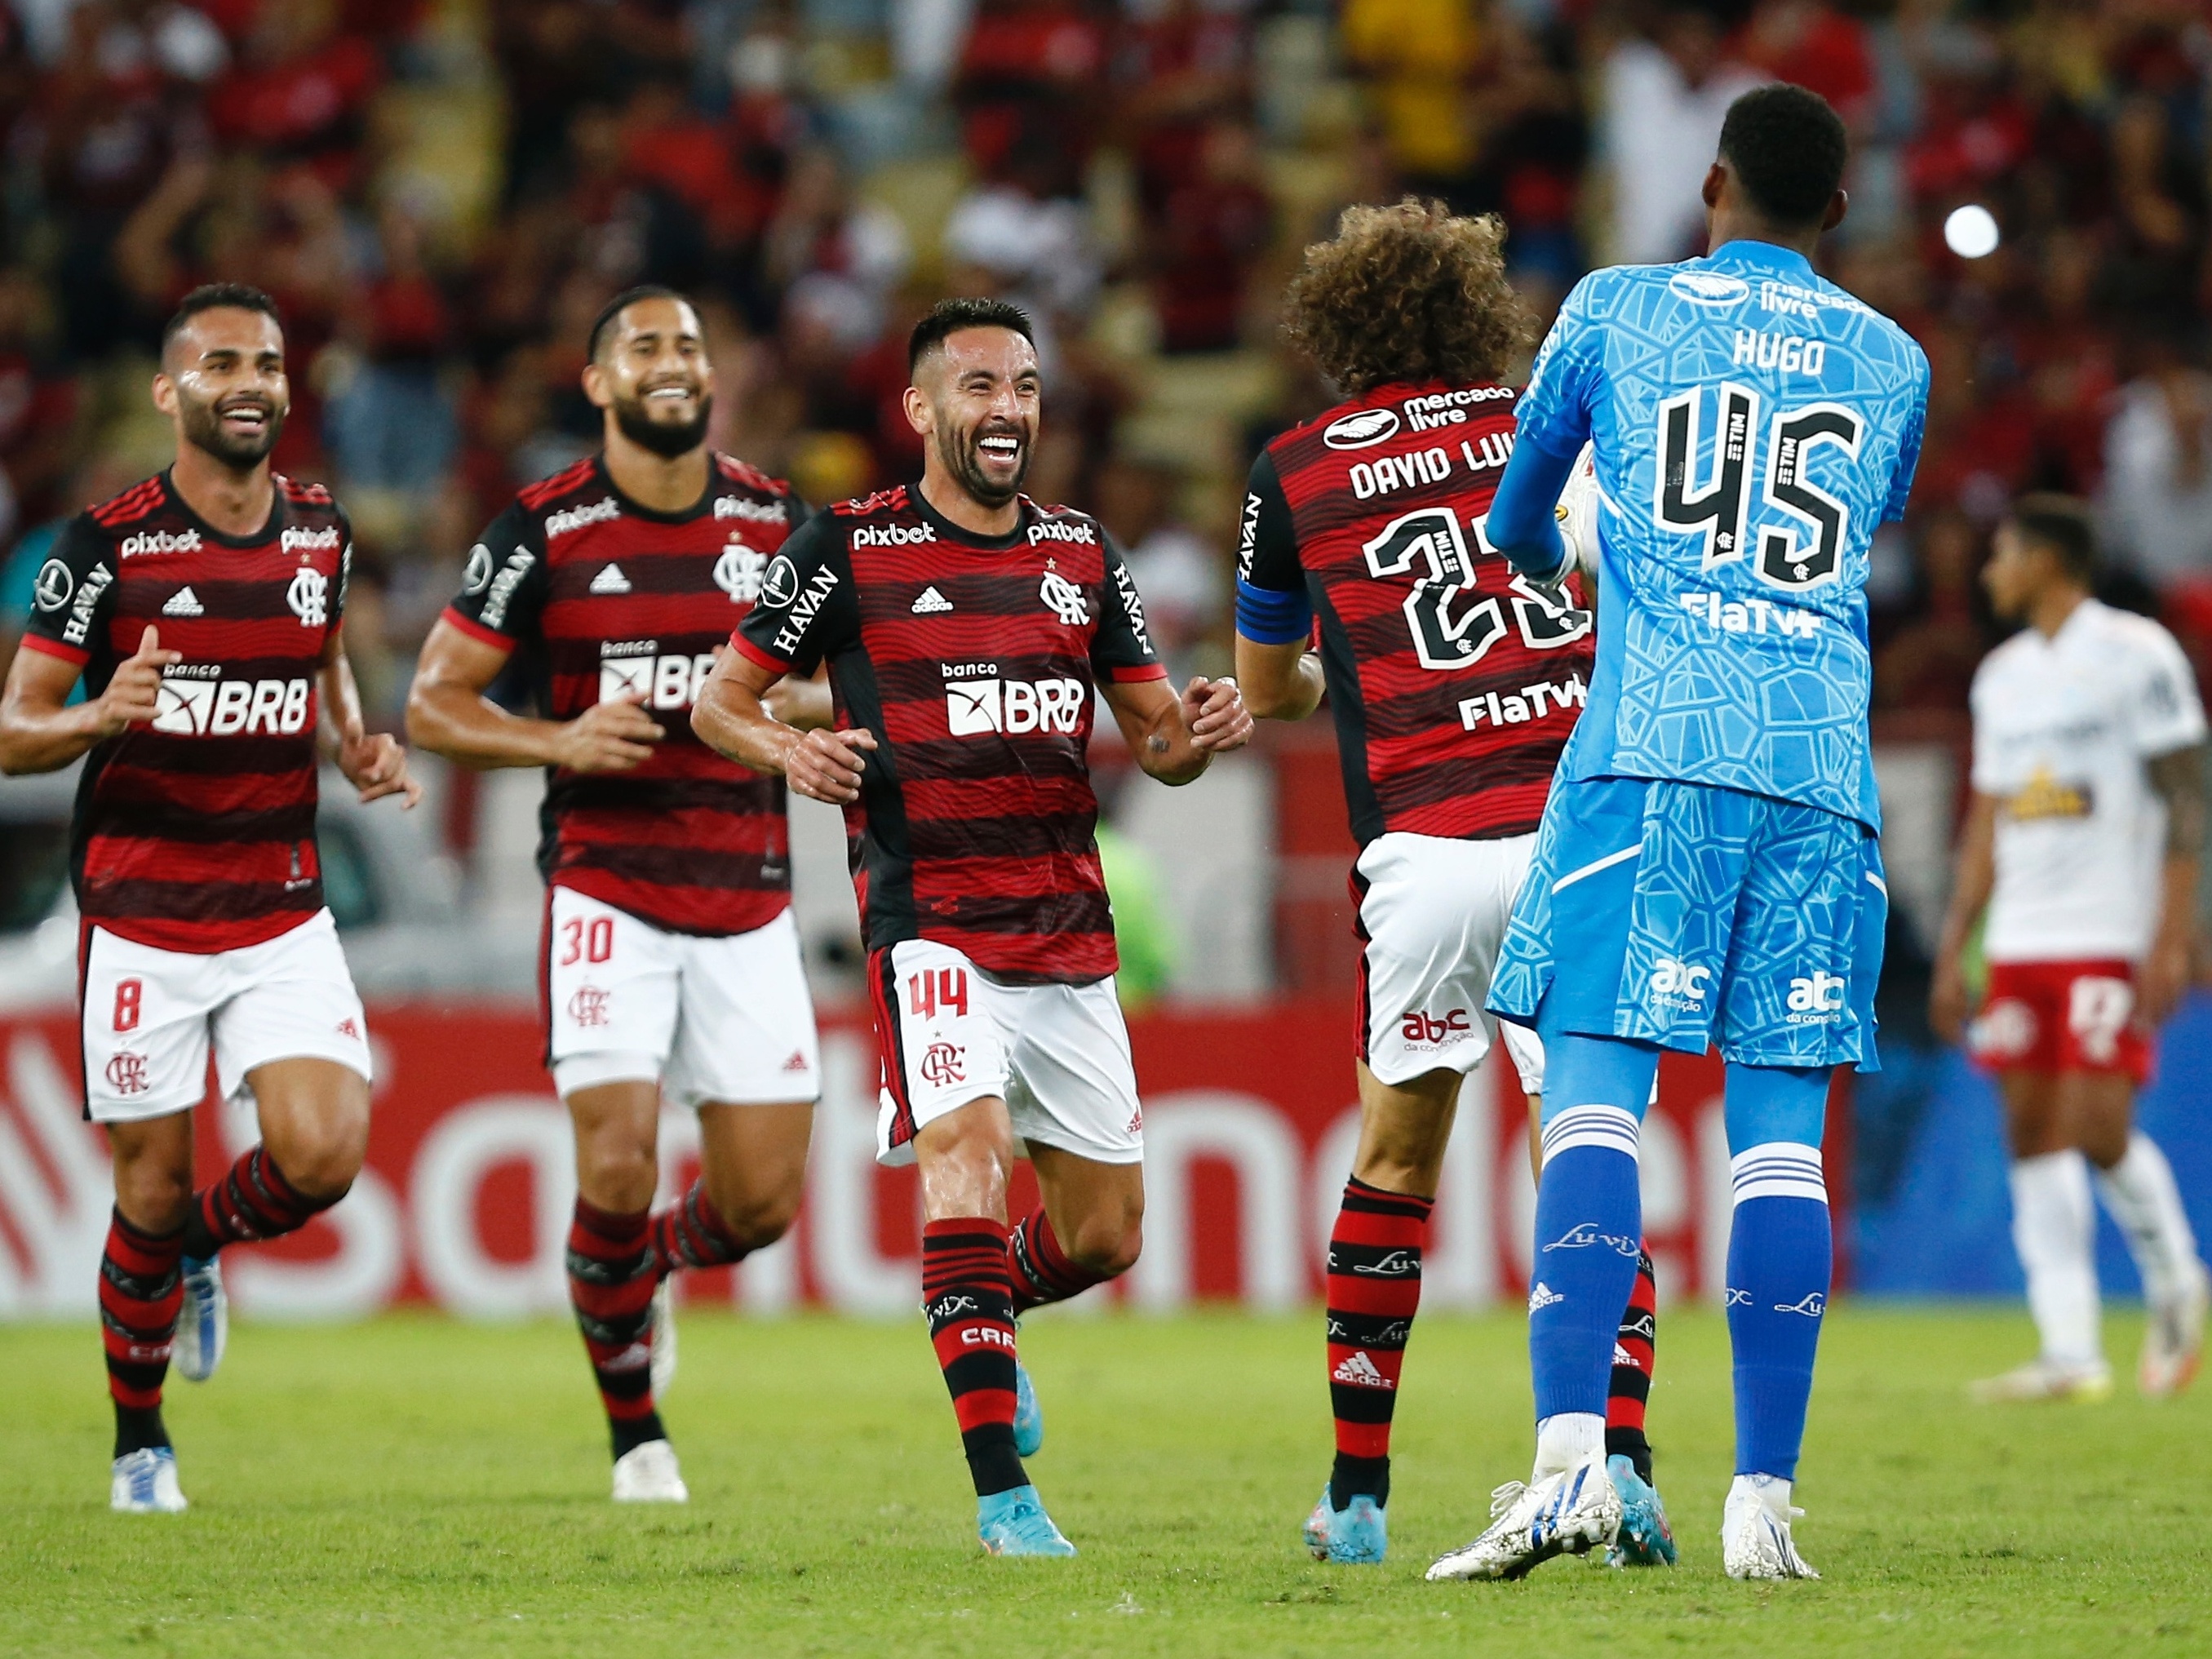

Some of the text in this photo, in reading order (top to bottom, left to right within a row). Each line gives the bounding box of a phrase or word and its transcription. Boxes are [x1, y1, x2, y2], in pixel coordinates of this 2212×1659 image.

[1760, 281, 1876, 319] mercado
[1760, 291, 1818, 319] livre
[1732, 328, 1826, 376] HUGO
[1403, 387, 1515, 415] mercado
[1407, 409, 1468, 432] livre
[1728, 412, 1746, 443] TIM
[1349, 432, 1517, 500] DAVID LUI
[1779, 436, 1798, 467] TIM
[1652, 380, 1864, 592] 45
[121, 528, 203, 560] pixbet
[853, 521, 938, 551] pixbet
[1026, 520, 1097, 548] pixbet
[1433, 530, 1454, 560] TIM
[62, 561, 114, 645] HAVAN
[773, 563, 840, 656] HAVAN
[911, 601, 954, 614] adidas
[1113, 562, 1155, 656] HAVAN
[941, 662, 998, 679] banco
[210, 678, 309, 734] BRB
[1004, 677, 1085, 734] BRB
[561, 917, 612, 965] 30
[113, 979, 142, 1032] 8
[907, 967, 969, 1022] 44
[1402, 1009, 1471, 1044] abc
[1785, 1013, 1801, 1024] da
[1403, 1043, 1418, 1052] da
